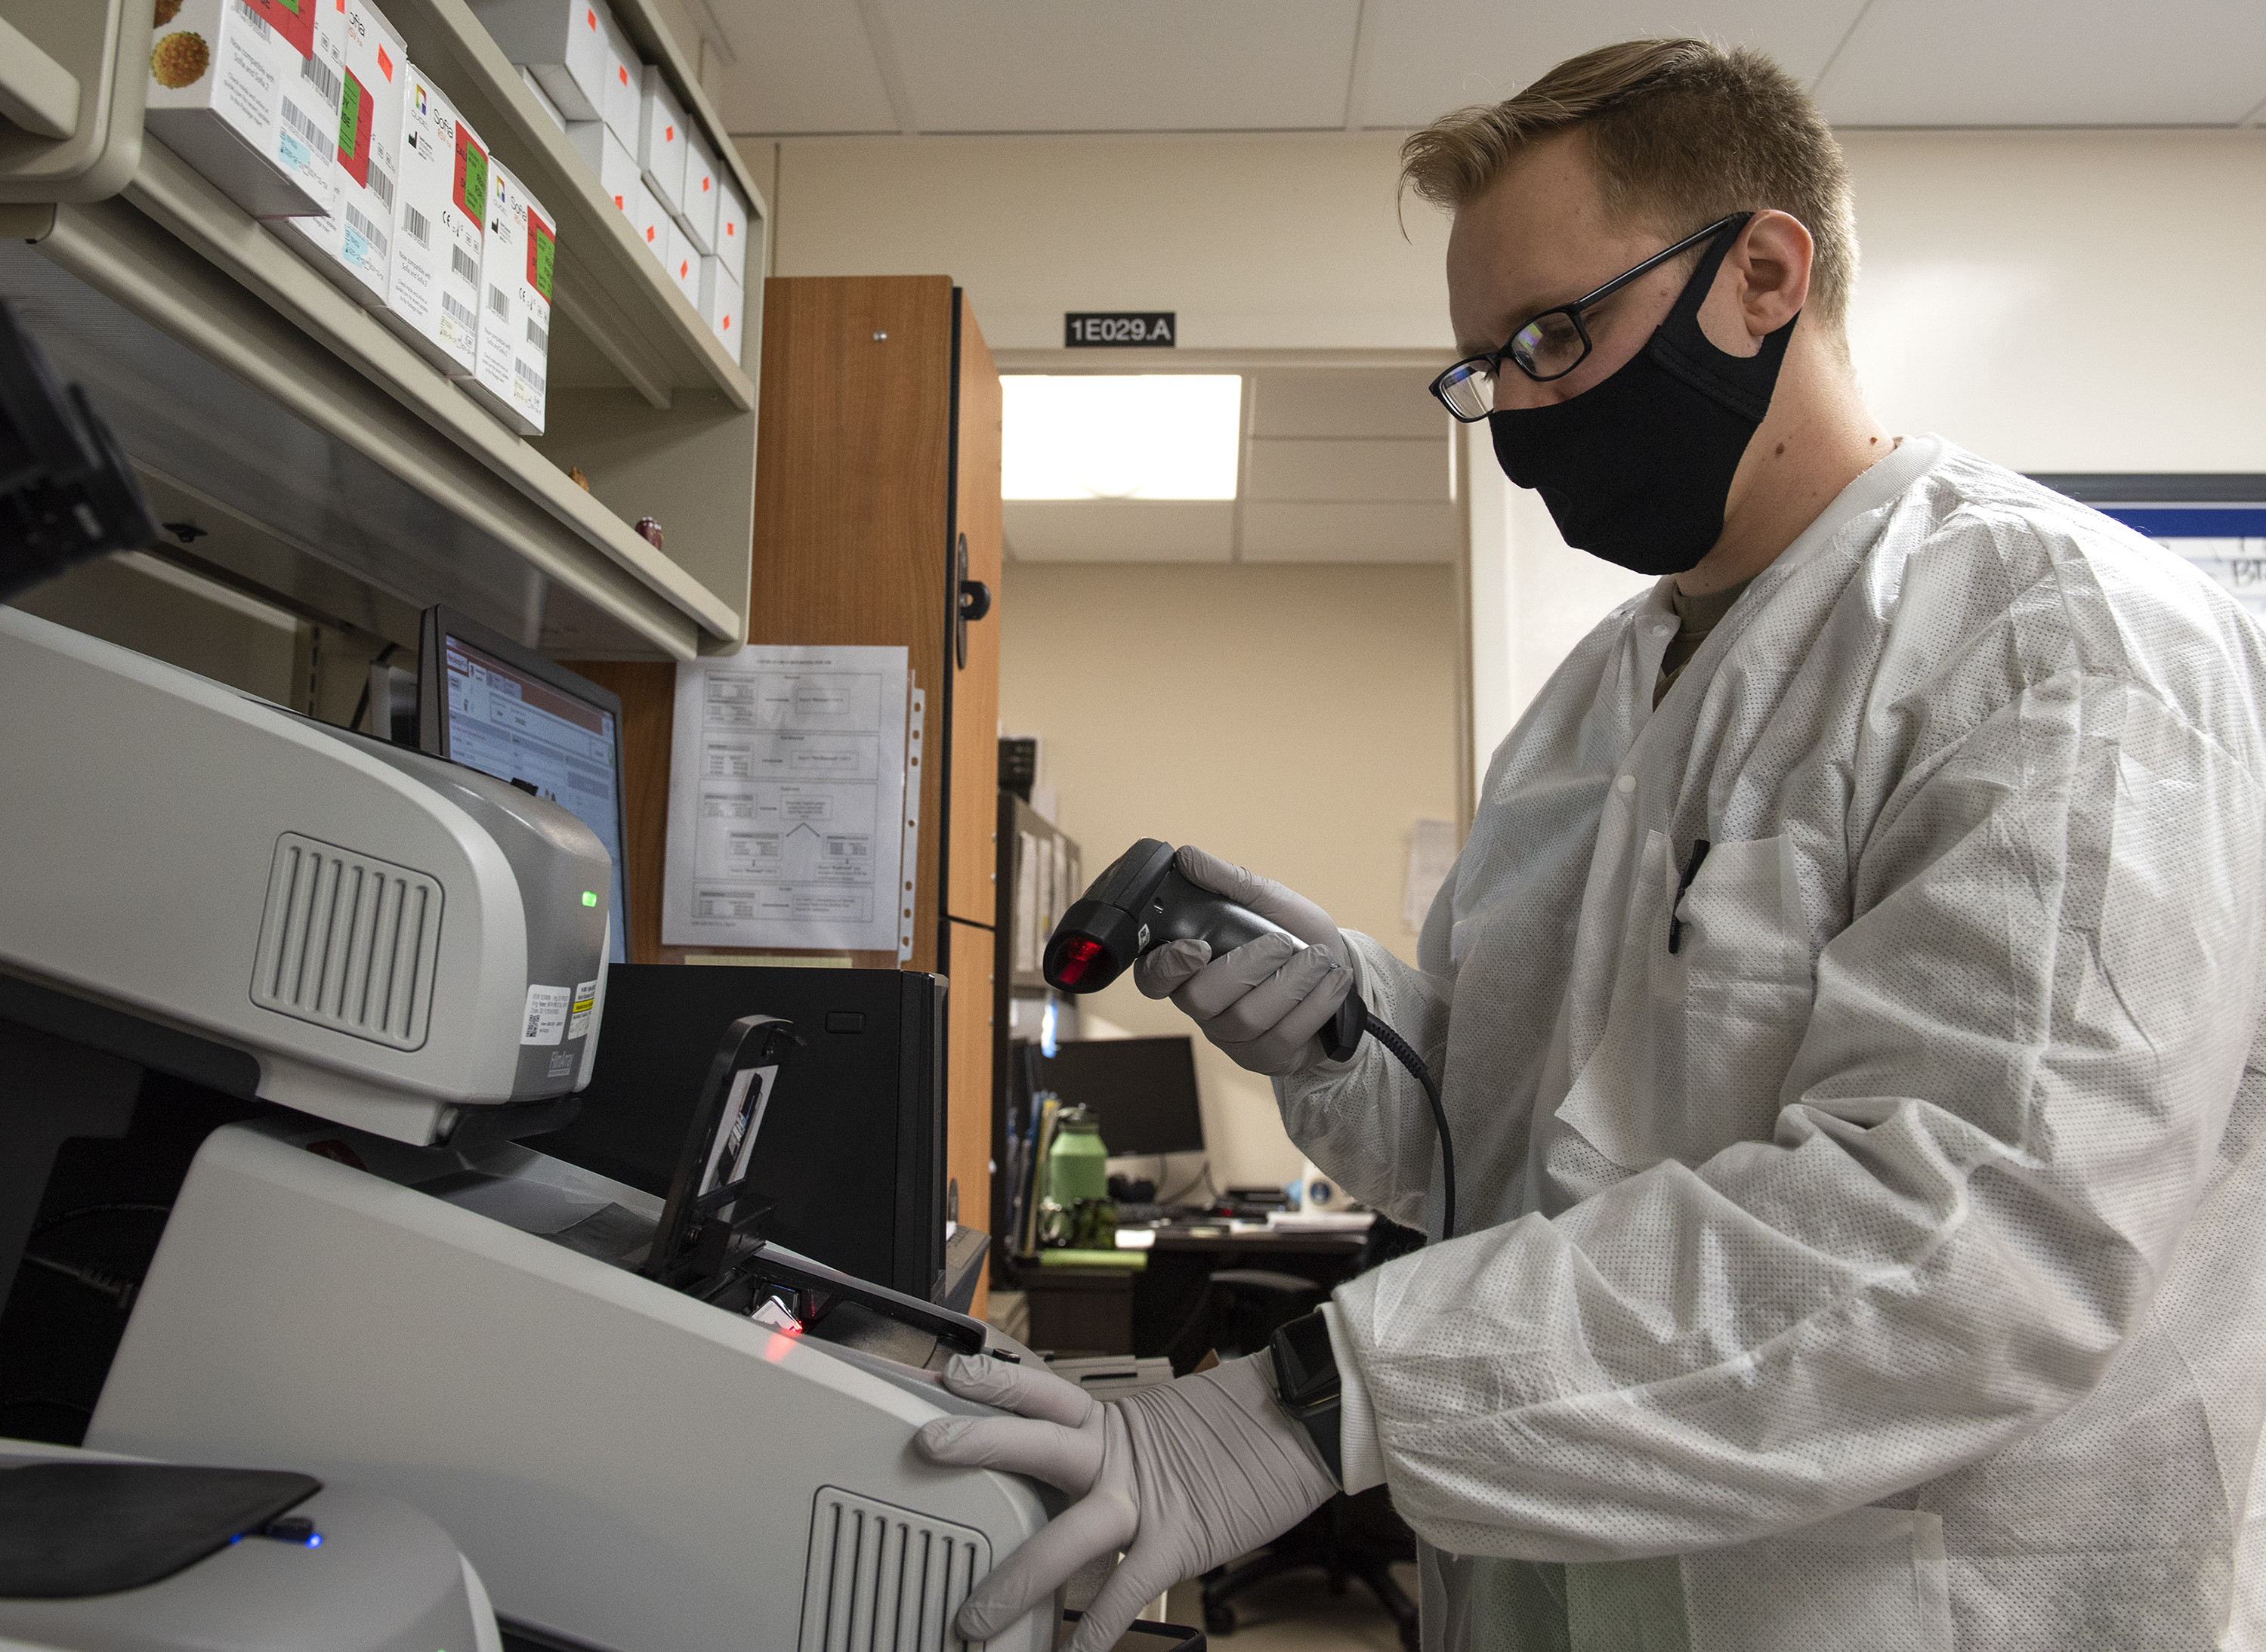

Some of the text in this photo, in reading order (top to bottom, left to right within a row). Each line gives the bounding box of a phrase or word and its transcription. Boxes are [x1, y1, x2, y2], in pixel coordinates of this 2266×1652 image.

[349, 11, 366, 37] ofia
[434, 108, 454, 140] Sofia
[511, 196, 527, 222] Sofia
[1070, 318, 1172, 341] 1E029.A
